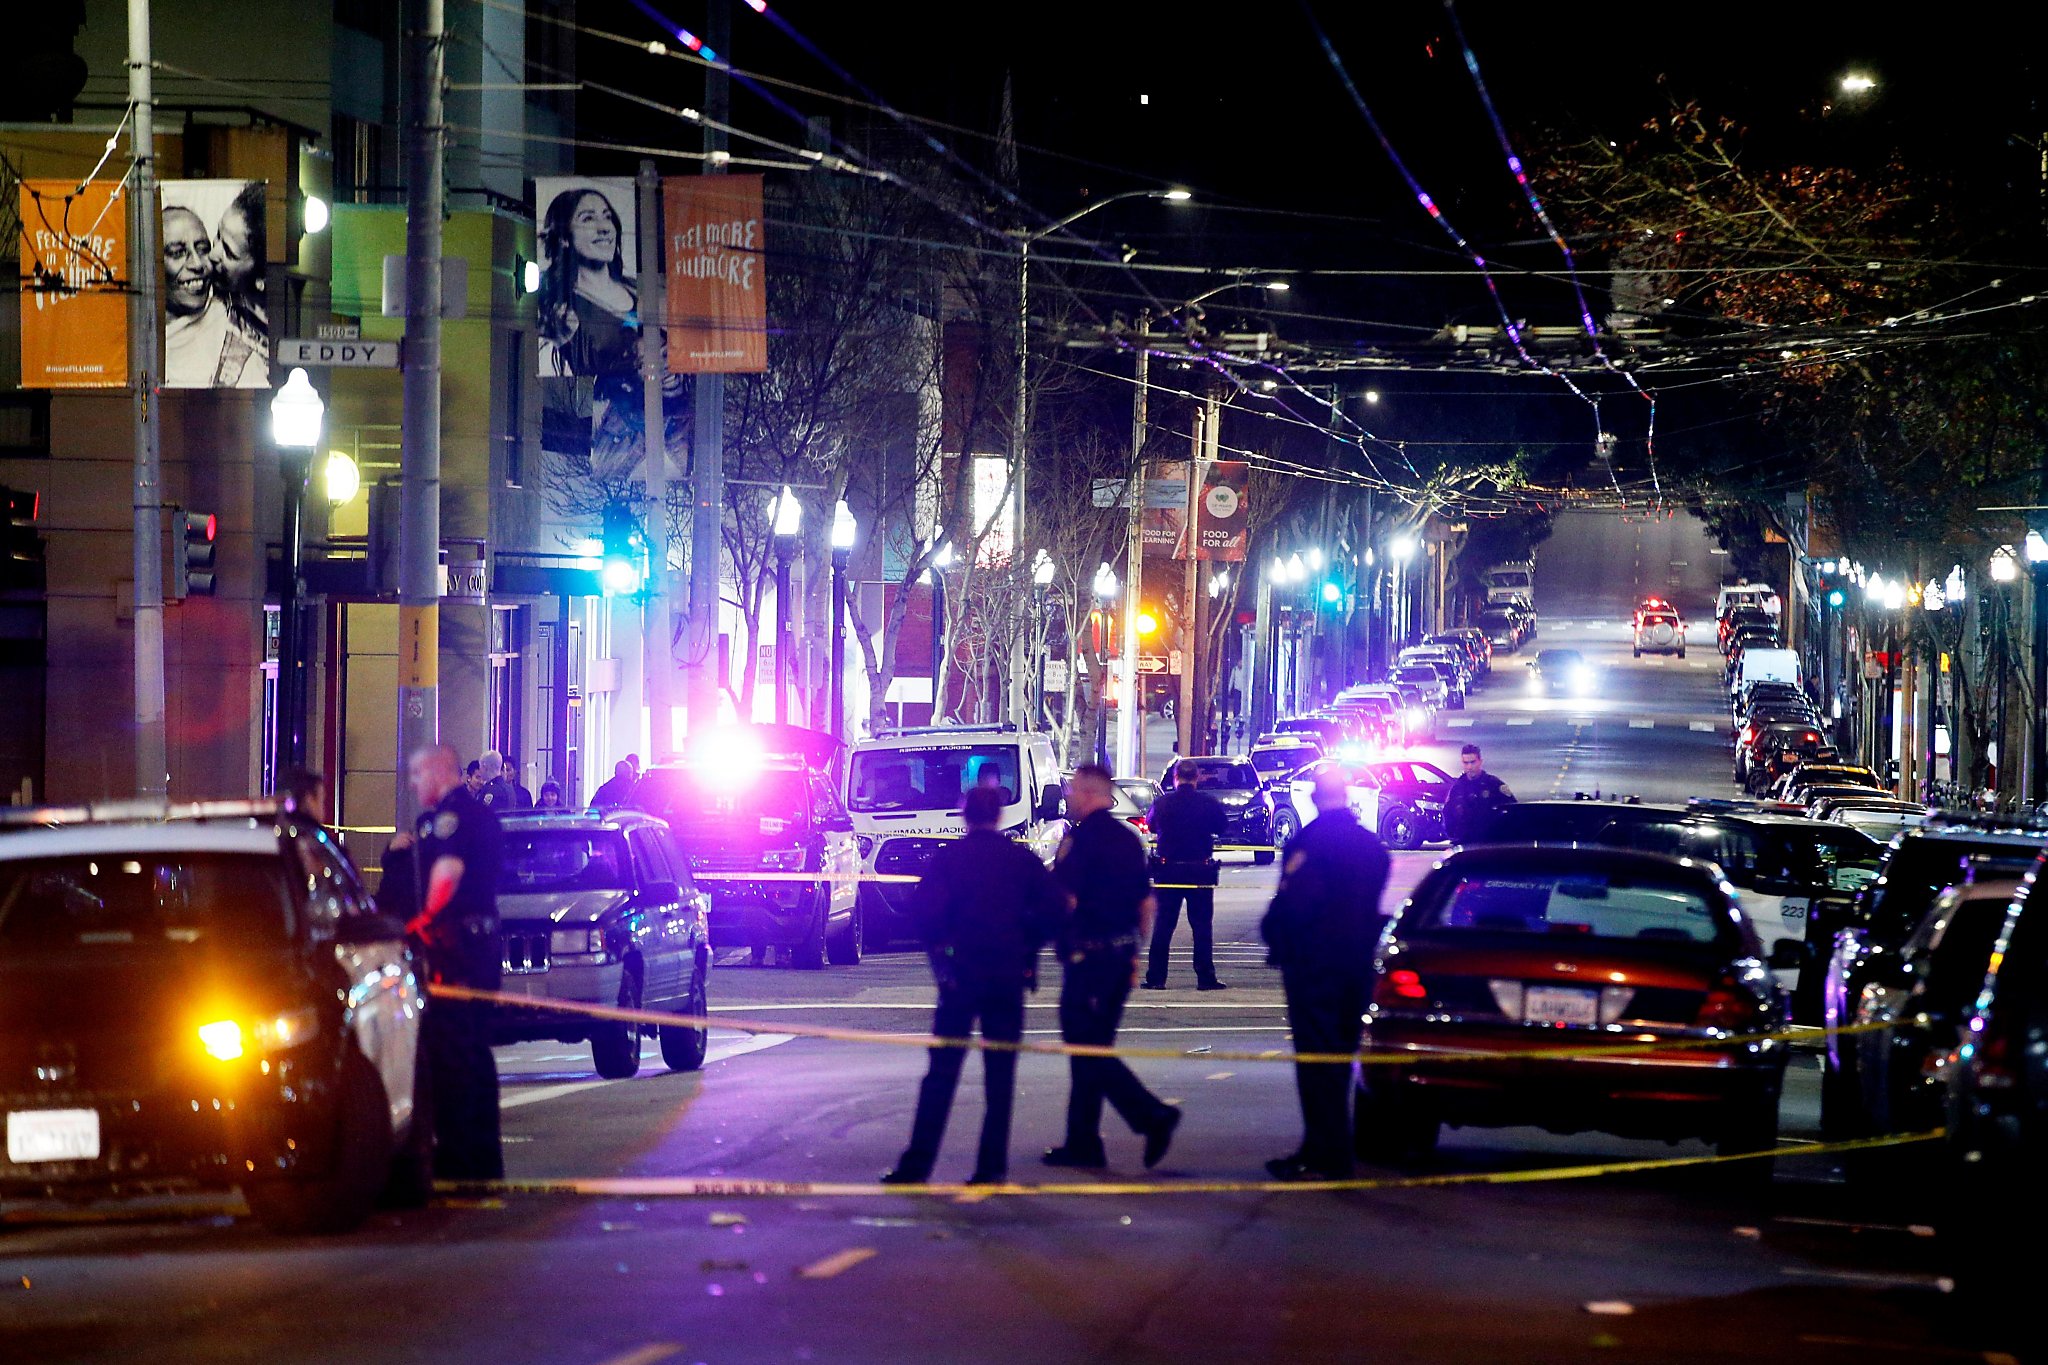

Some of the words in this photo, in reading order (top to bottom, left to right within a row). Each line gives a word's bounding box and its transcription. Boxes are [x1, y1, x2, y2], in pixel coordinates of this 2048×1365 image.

[299, 344, 376, 361] EDDY
[1203, 531, 1228, 539] FOOD
[1203, 539, 1221, 547] FOR
[1222, 536, 1241, 548] all
[1781, 905, 1805, 918] 223
